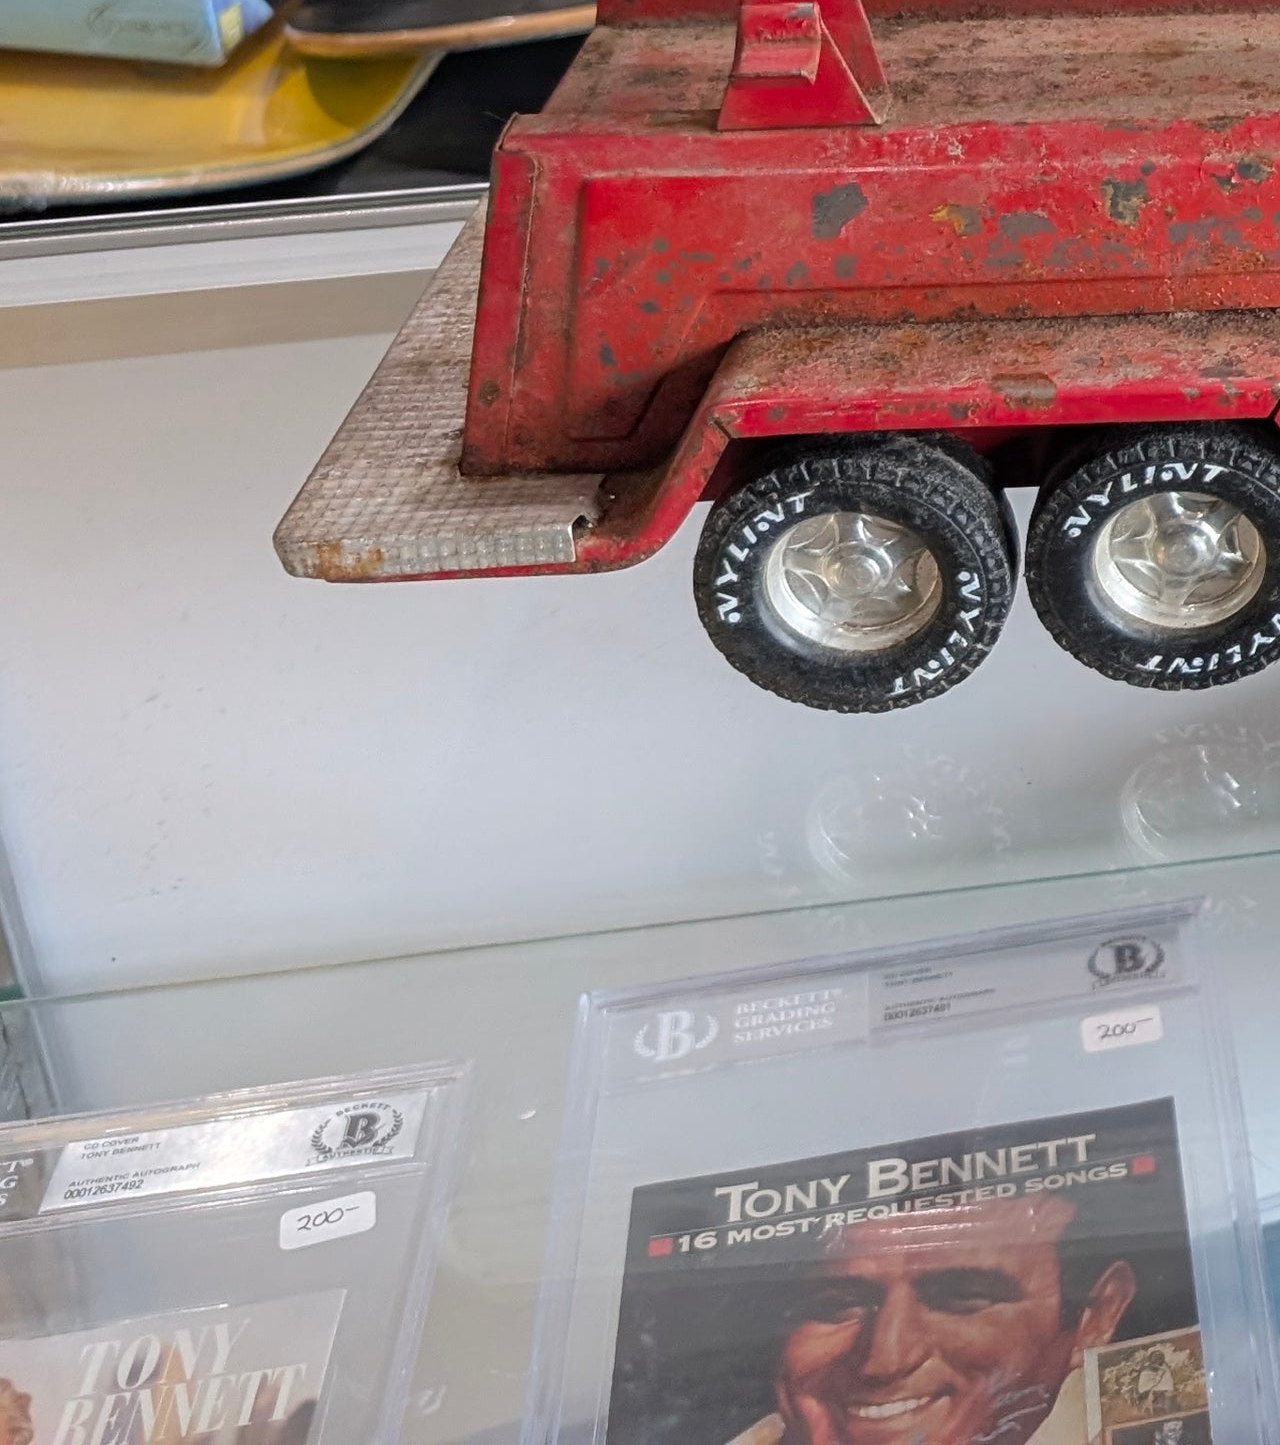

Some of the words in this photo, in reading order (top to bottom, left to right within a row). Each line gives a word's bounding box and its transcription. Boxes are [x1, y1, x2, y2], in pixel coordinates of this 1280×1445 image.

[1063, 462, 1230, 538] NYLINT
[715, 489, 815, 624] NYLINT
[888, 570, 983, 696] NYLINT
[734, 1002, 837, 1029] GRADING
[733, 1017, 834, 1043] SERVICES
[335, 1103, 391, 1117] BECKETT
[80, 1149, 110, 1160] TONY
[112, 1141, 162, 1156] BENNETT
[101, 1136, 140, 1149] COVER
[68, 1171, 130, 1188] AUTHENTIC
[132, 1162, 201, 1179] AUTOGRAPH
[63, 1178, 145, 1201] 00012637492
[678, 1231, 718, 1252] 16
[727, 1217, 817, 1245] MOST
[824, 1183, 1017, 1229] REQUESTED
[1024, 1162, 1128, 1193] SONGS
[80, 1318, 250, 1400] TONY
[52, 1362, 308, 1445] BENNETT
